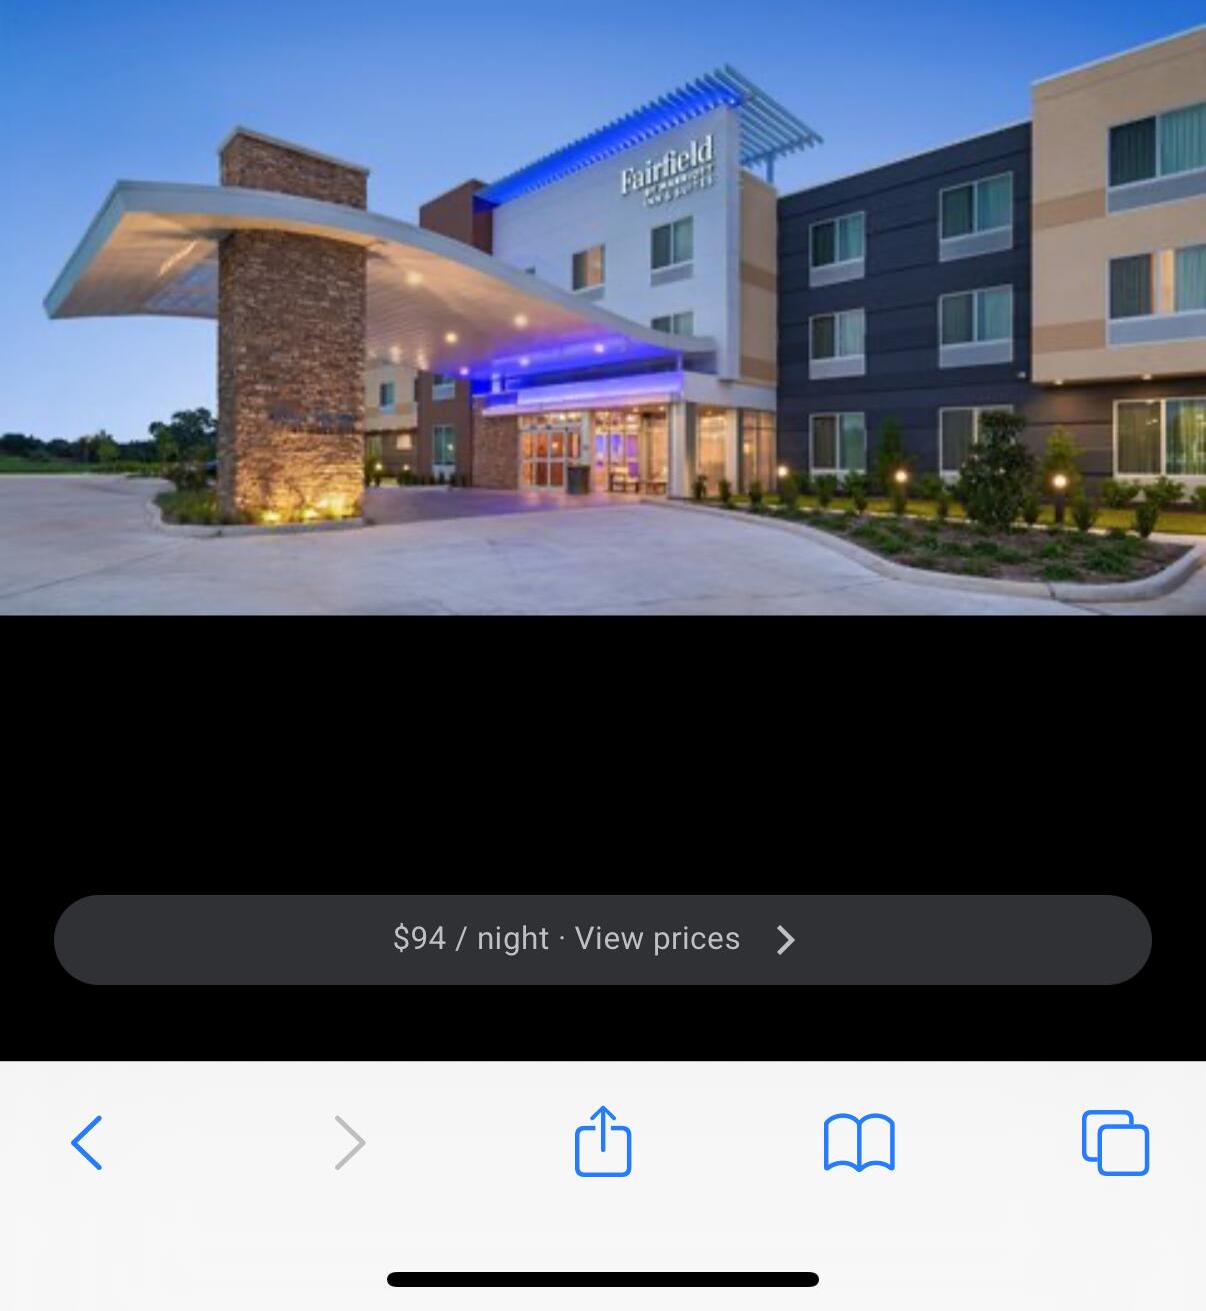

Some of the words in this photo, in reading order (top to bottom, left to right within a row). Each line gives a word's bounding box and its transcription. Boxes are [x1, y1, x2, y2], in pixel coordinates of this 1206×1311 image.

[621, 135, 713, 195] Fairfield
[393, 922, 447, 953] $94
[455, 925, 468, 952] /
[478, 924, 549, 957] night
[574, 925, 644, 950] View
[654, 925, 740, 957] prices
